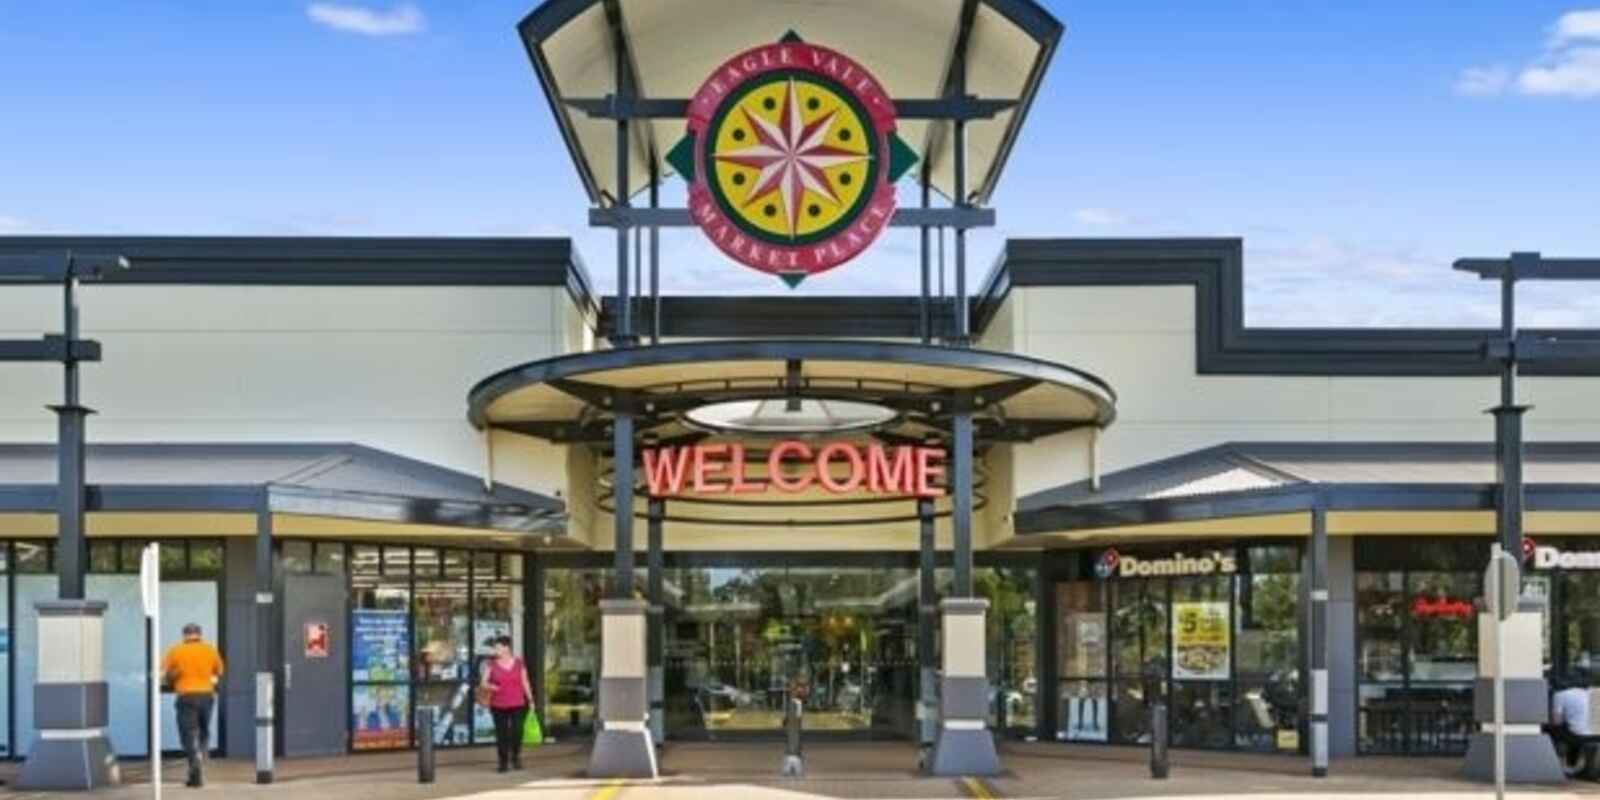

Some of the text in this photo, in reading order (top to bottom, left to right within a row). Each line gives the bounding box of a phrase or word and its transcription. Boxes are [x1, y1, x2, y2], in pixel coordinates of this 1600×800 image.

[710, 49, 871, 94] EAGLE VALE
[701, 203, 886, 265] MARKET PLACE
[642, 440, 947, 497] WELCOME
[1120, 551, 1236, 576] Domino's
